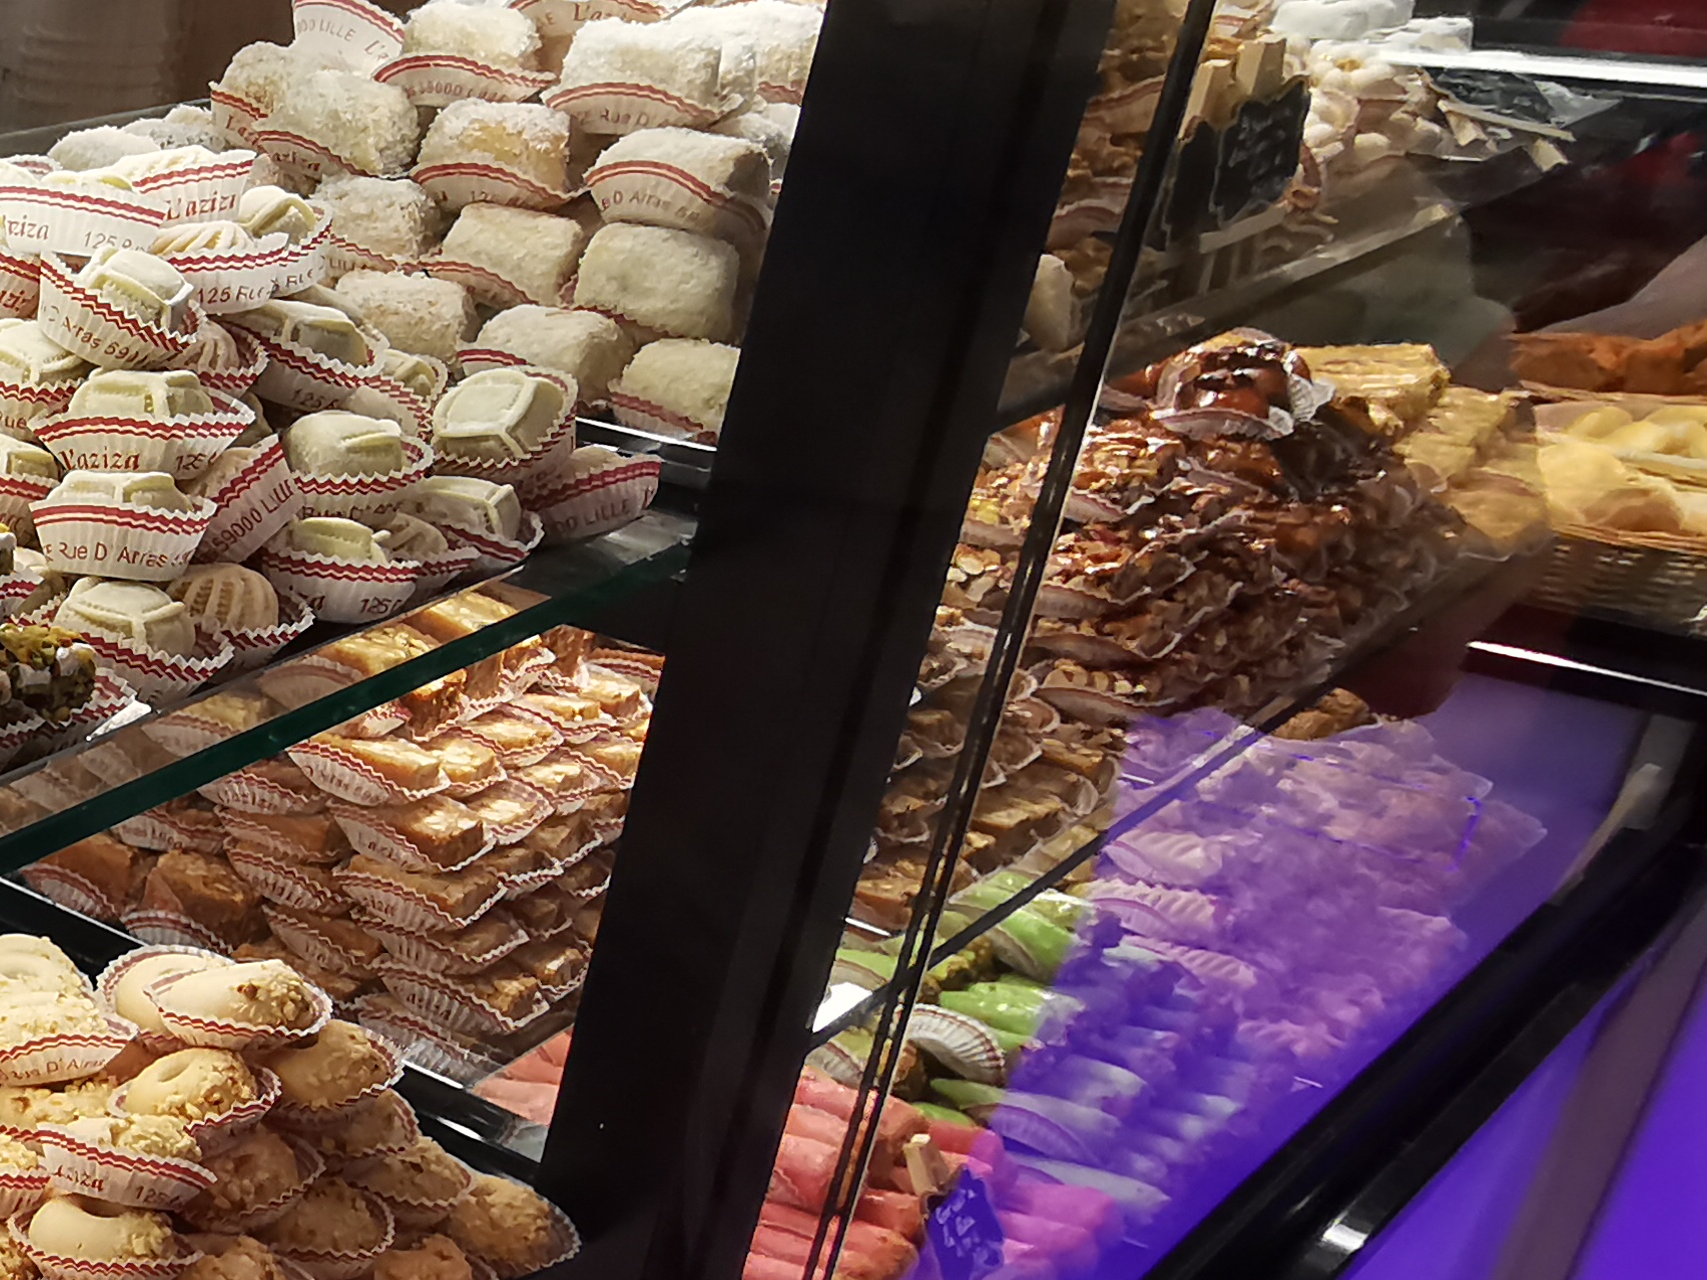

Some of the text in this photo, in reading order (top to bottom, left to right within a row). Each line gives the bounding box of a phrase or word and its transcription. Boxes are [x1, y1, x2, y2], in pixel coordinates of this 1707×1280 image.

[318, 19, 357, 42] LILLE
[197, 286, 231, 305] 125
[116, 541, 169, 569] Arras
